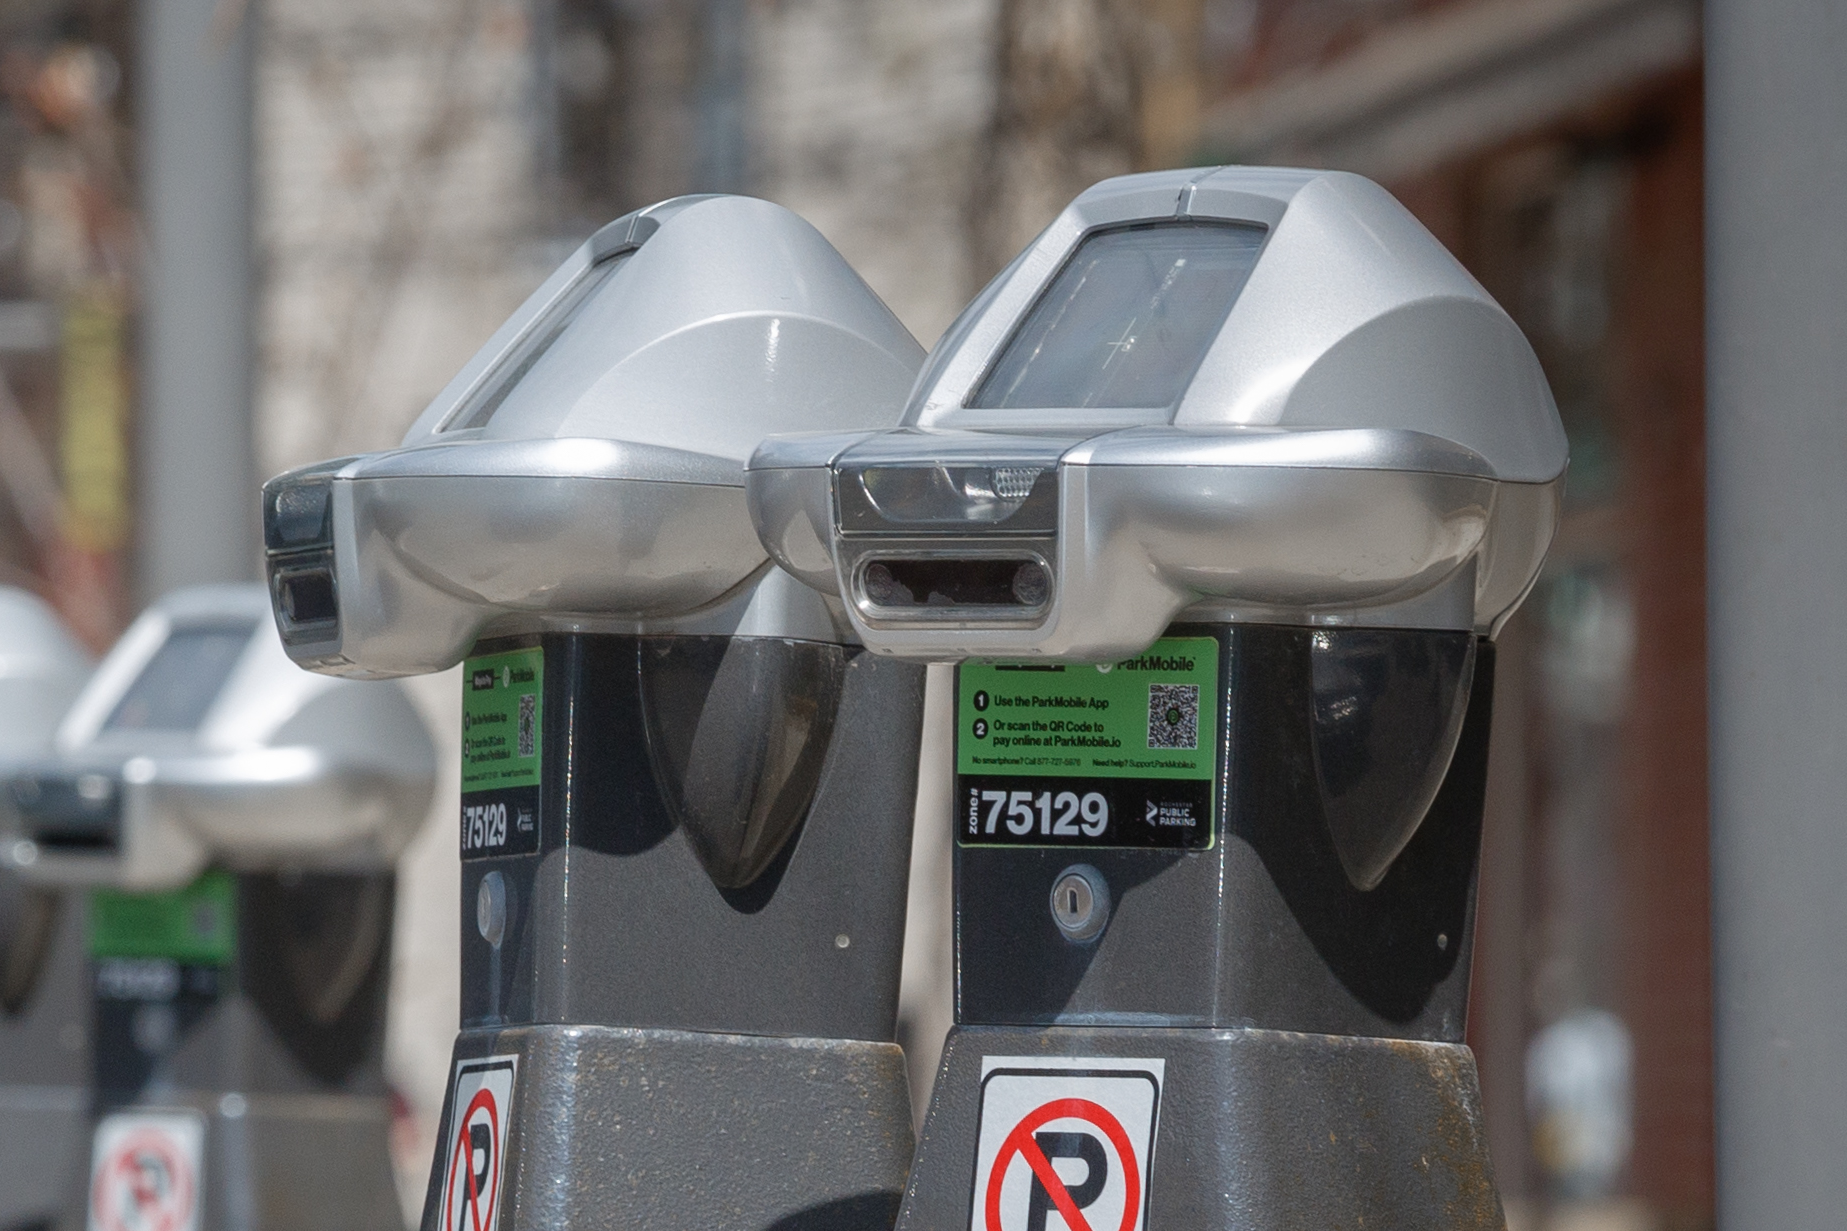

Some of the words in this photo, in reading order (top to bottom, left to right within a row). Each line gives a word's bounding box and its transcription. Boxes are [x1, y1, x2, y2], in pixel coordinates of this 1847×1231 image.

[994, 695, 1013, 707] Use
[1015, 696, 1030, 707] the
[1031, 696, 1087, 708] ParkMobile
[1089, 697, 1109, 710] App
[993, 720, 1006, 731] Or
[1007, 721, 1030, 732] scan
[1032, 721, 1047, 732] the
[1049, 721, 1064, 732] QR
[1066, 721, 1092, 733] Code
[1094, 722, 1104, 733] to
[993, 736, 1011, 748] pay
[1012, 735, 1041, 746] online
[1043, 736, 1053, 747] at
[1054, 735, 1121, 748] ParkMobile.io
[982, 790, 1108, 837] 75129
[1159, 807, 1190, 817] PUBLIC
[466, 803, 507, 849] 75129
[1159, 816, 1197, 827] PARKING
